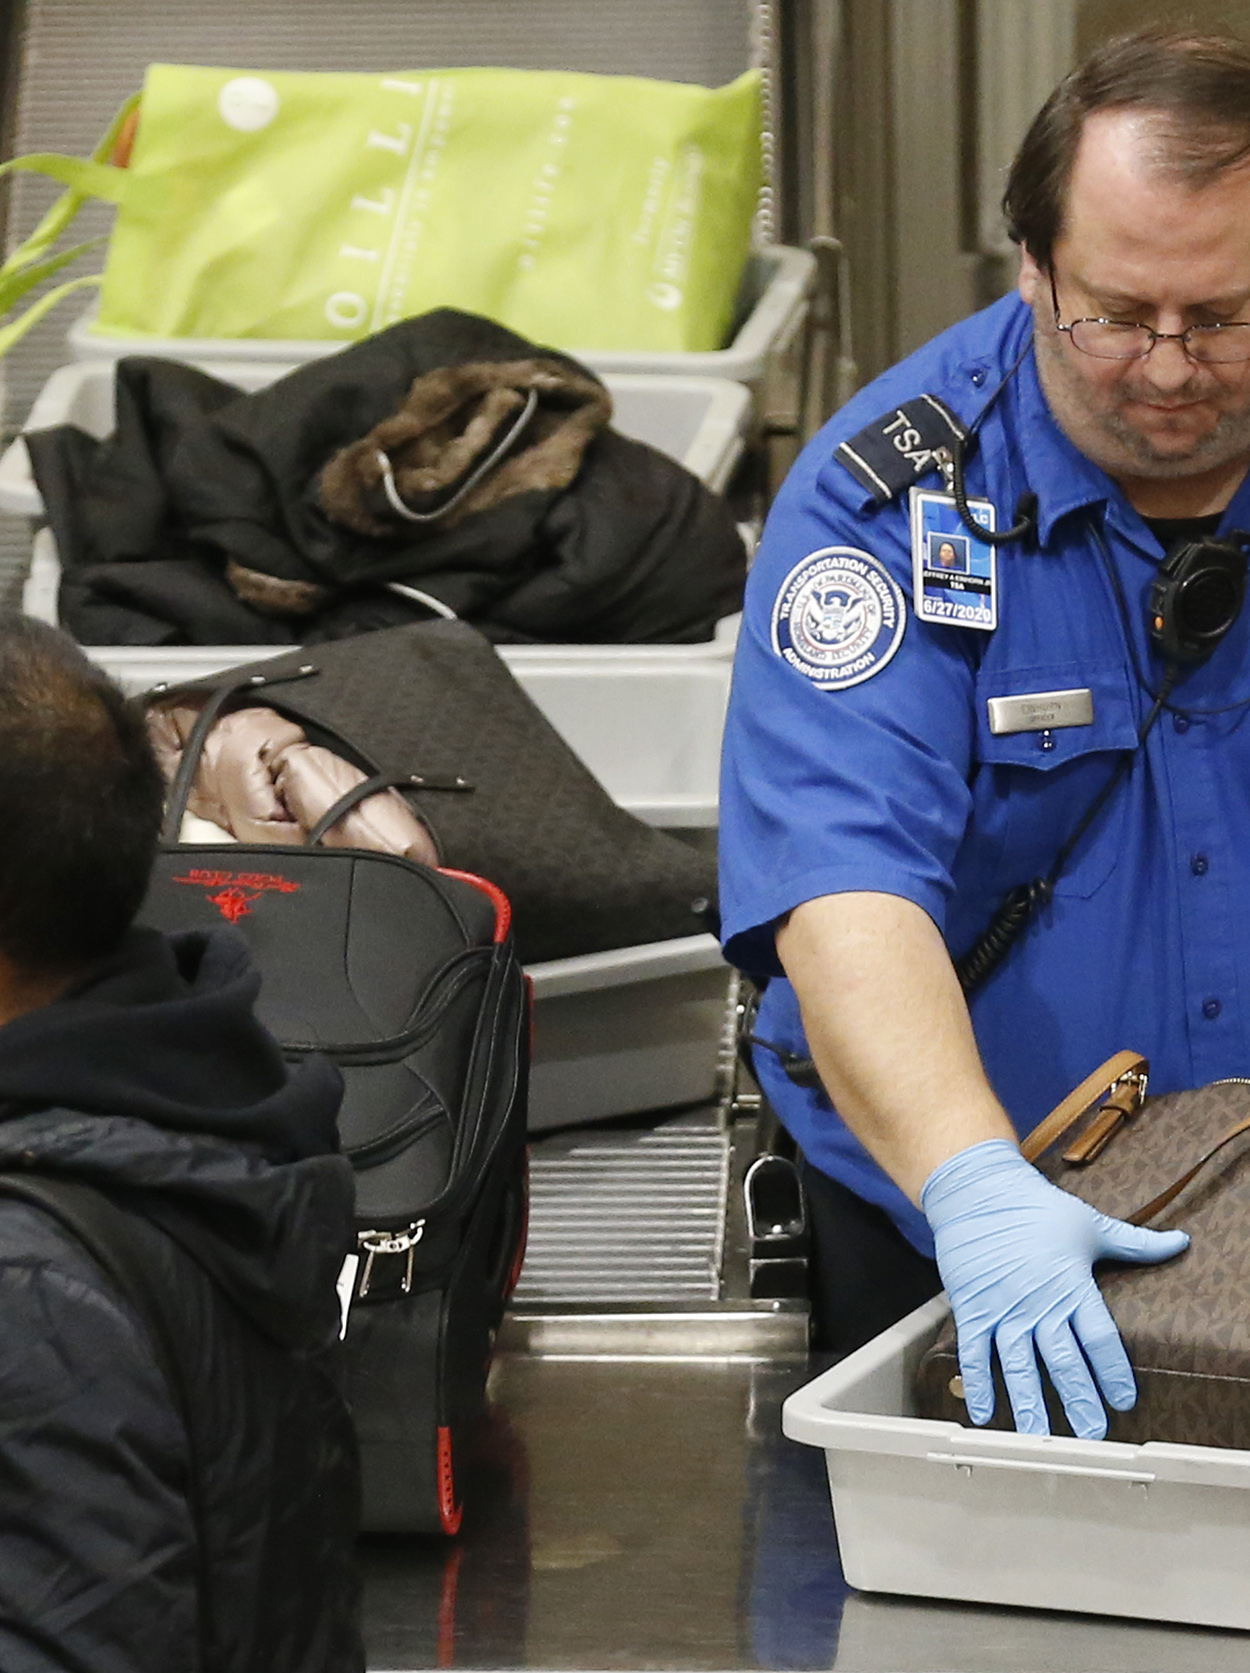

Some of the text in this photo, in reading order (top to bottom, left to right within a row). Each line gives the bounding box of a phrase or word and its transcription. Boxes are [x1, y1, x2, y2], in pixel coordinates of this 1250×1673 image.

[882, 411, 932, 472] TSA
[780, 557, 895, 629] TRANSPORTATION SECURITY
[923, 600, 991, 622] 6/27/2020
[782, 647, 875, 680] ADMINISTRATION
